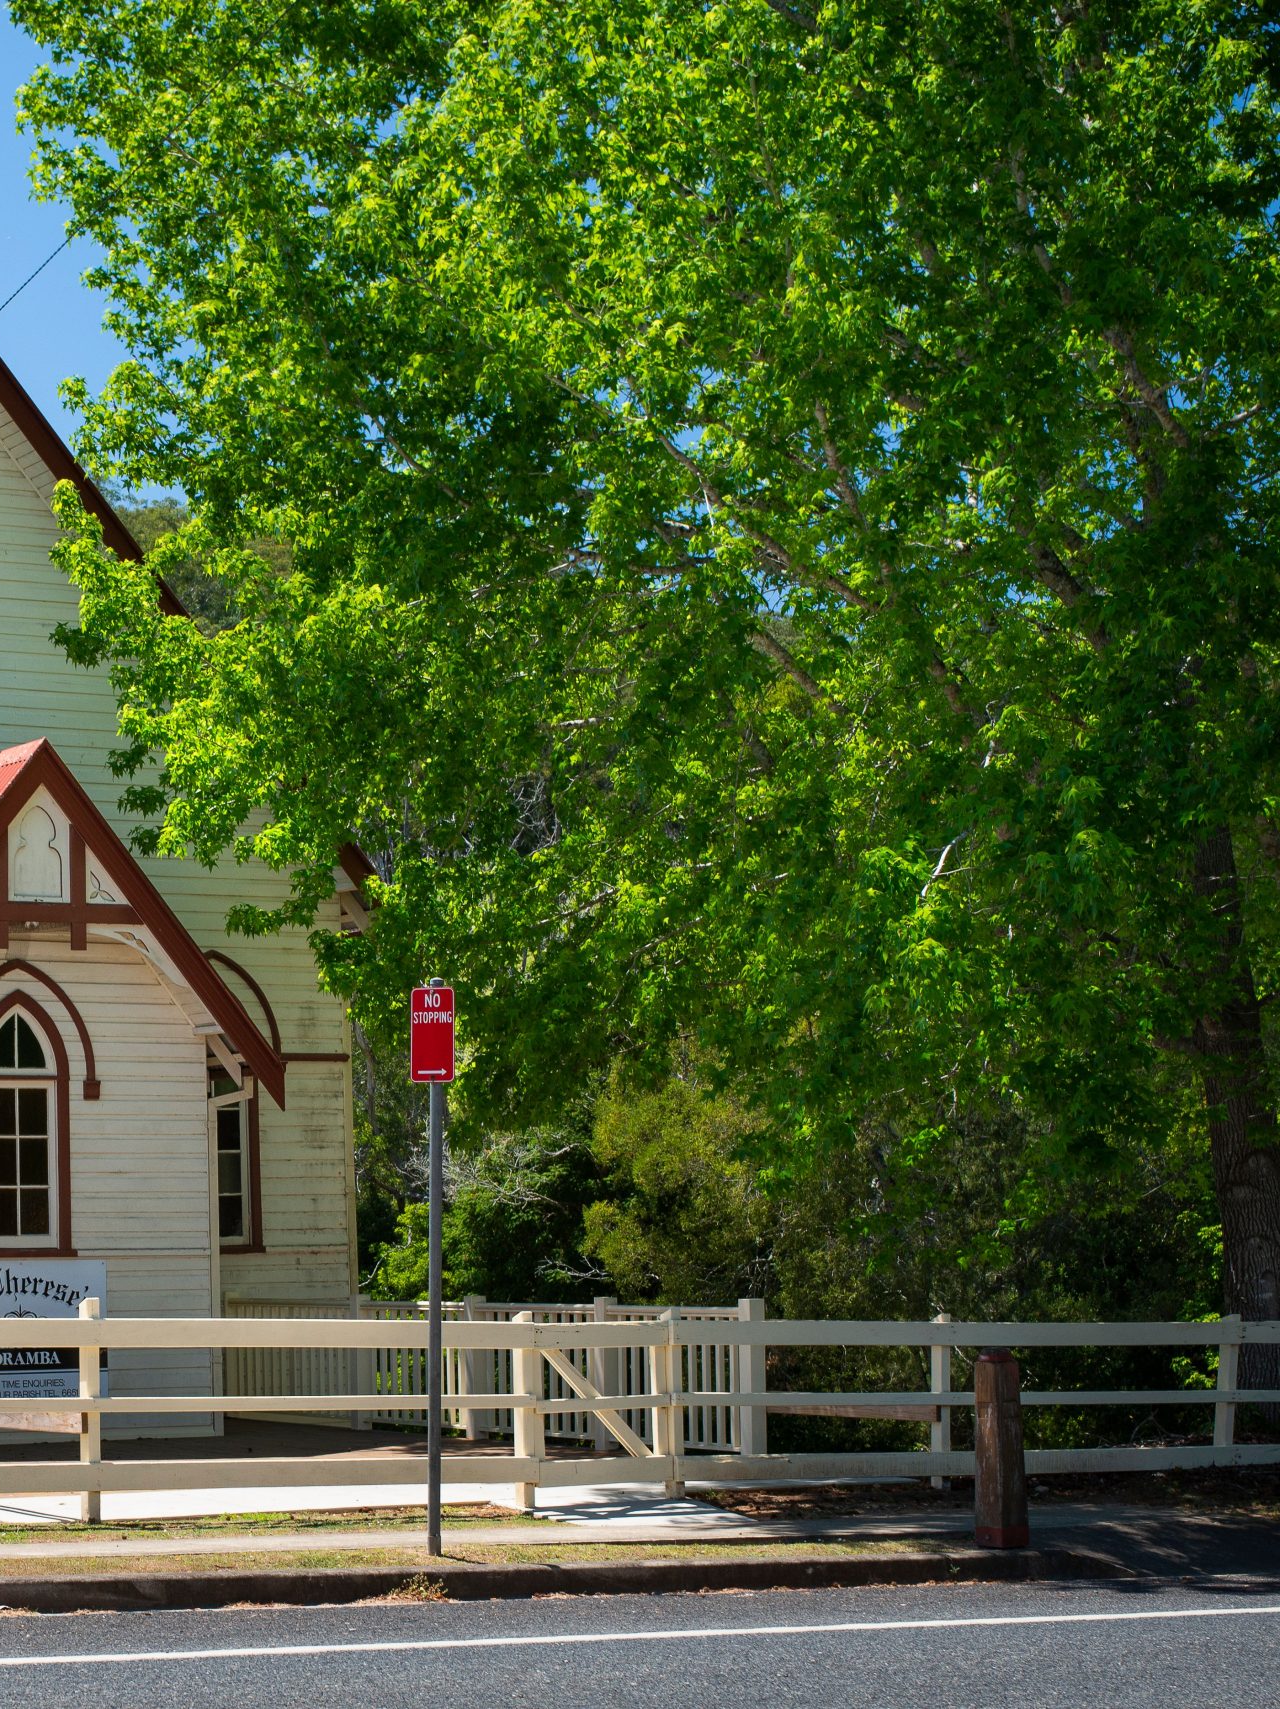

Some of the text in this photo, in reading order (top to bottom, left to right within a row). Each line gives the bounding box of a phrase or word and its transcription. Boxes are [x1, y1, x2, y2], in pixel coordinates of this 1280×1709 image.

[424, 993, 441, 1008] NO
[413, 1011, 453, 1024] STOPPING
[1, 1379, 21, 1389] TIME
[13, 1389, 42, 1398] PARISH
